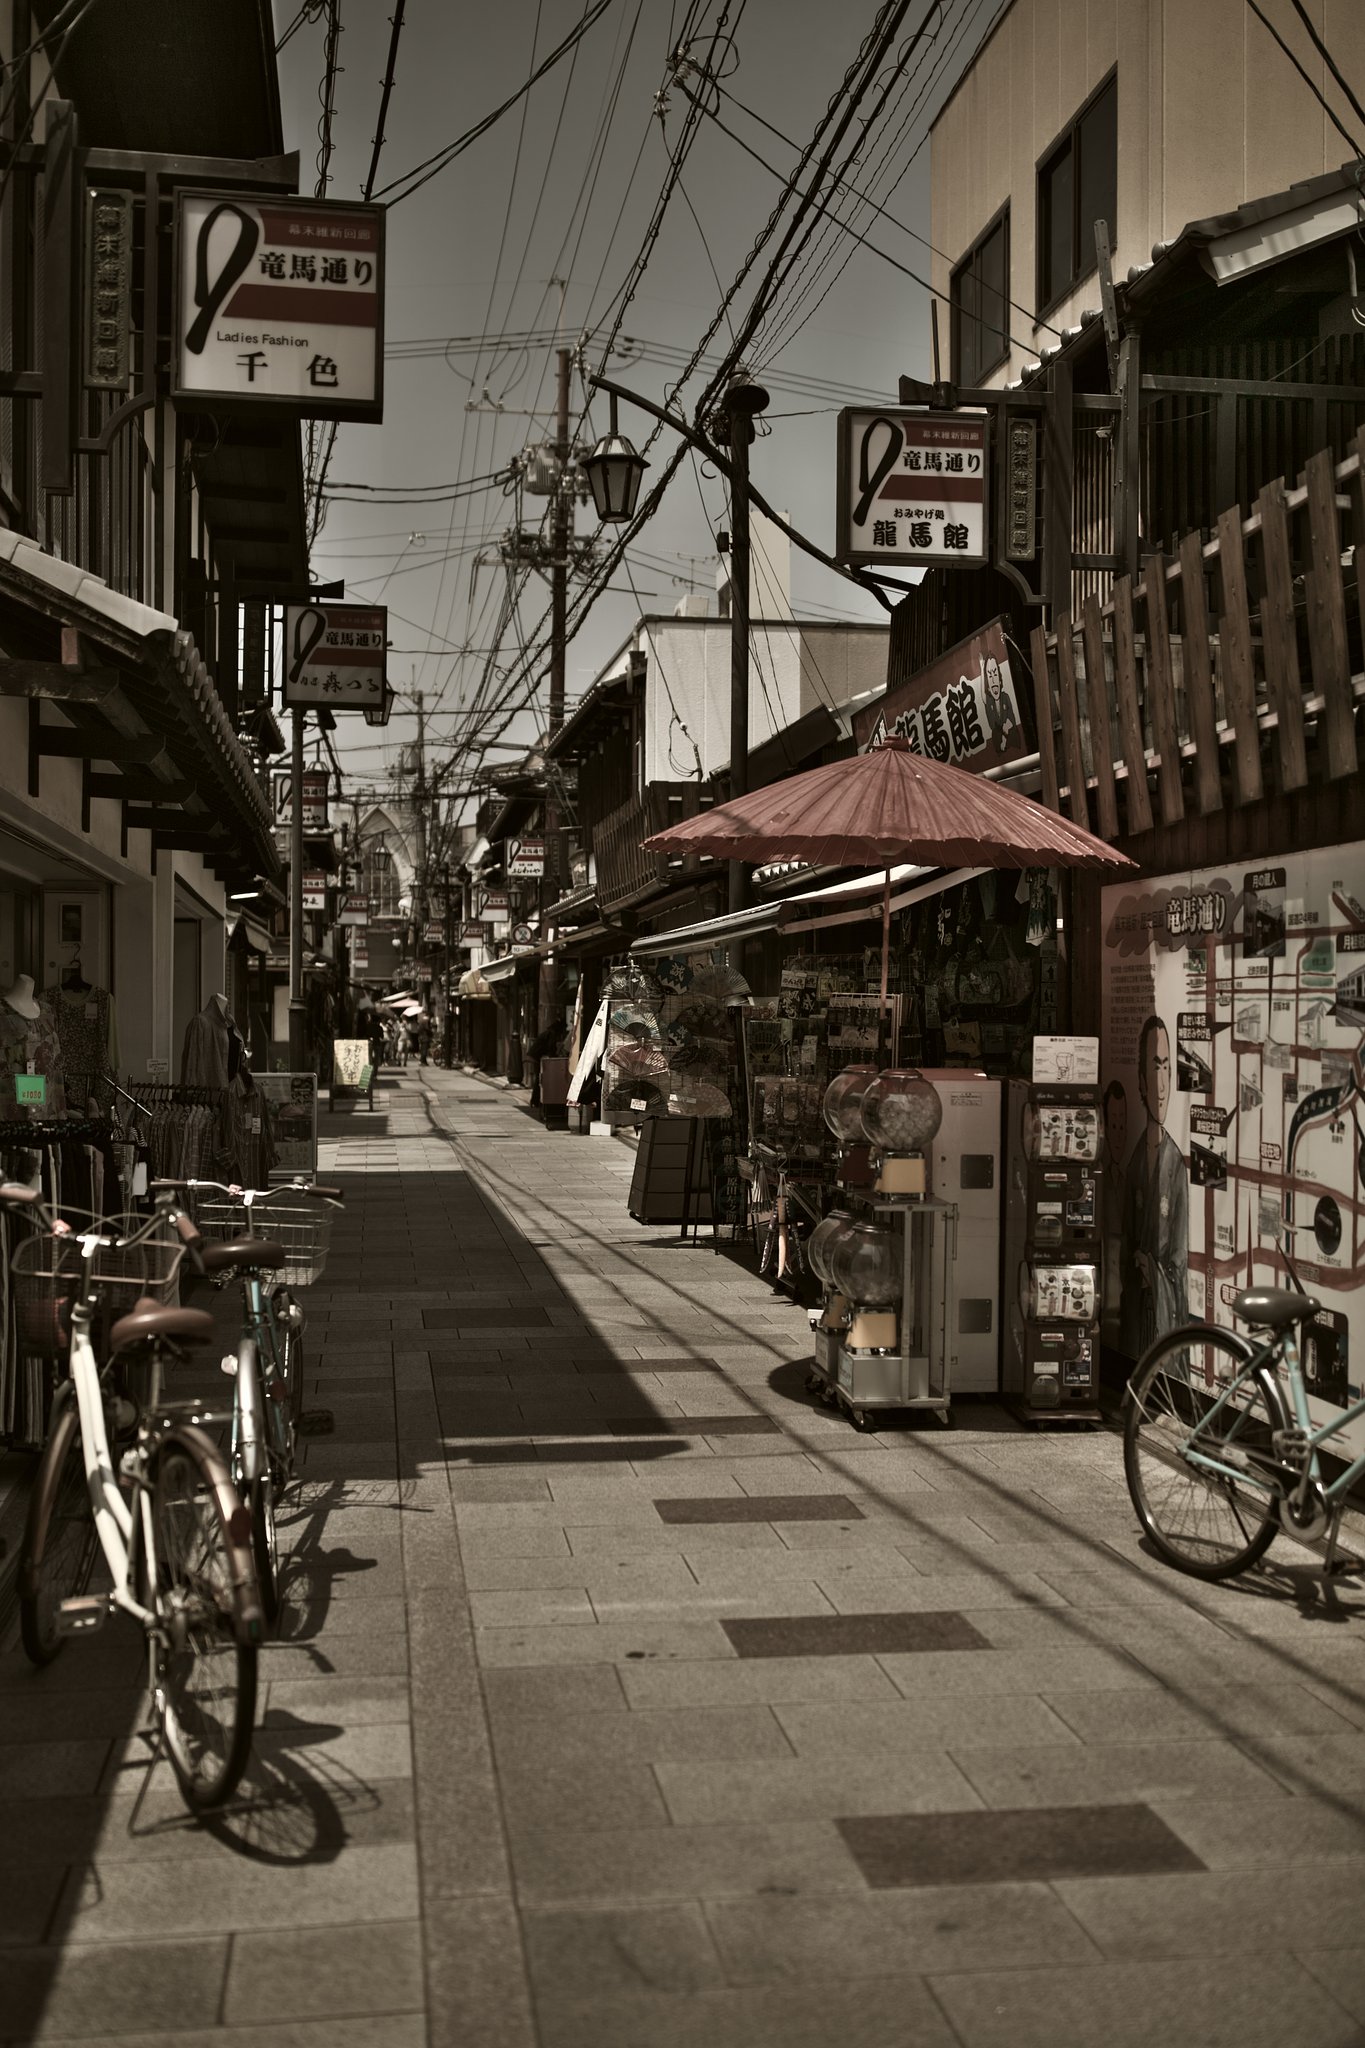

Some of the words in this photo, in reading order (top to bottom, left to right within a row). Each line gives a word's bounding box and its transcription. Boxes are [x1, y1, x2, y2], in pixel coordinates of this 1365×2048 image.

[288, 223, 371, 240] 幕末維新回廊
[258, 252, 373, 286] 竜馬通り
[216, 331, 258, 345] Ladies
[262, 334, 309, 348] Fashion
[236, 352, 339, 387] 千色
[922, 430, 979, 441] 幕末維新回廊
[902, 451, 981, 473] 竜馬通り
[893, 508, 945, 520] おみやげ処
[873, 520, 968, 550] 龍馬館
[326, 632, 381, 647] 竜馬通り
[1166, 893, 1226, 936] 竜馬通り
